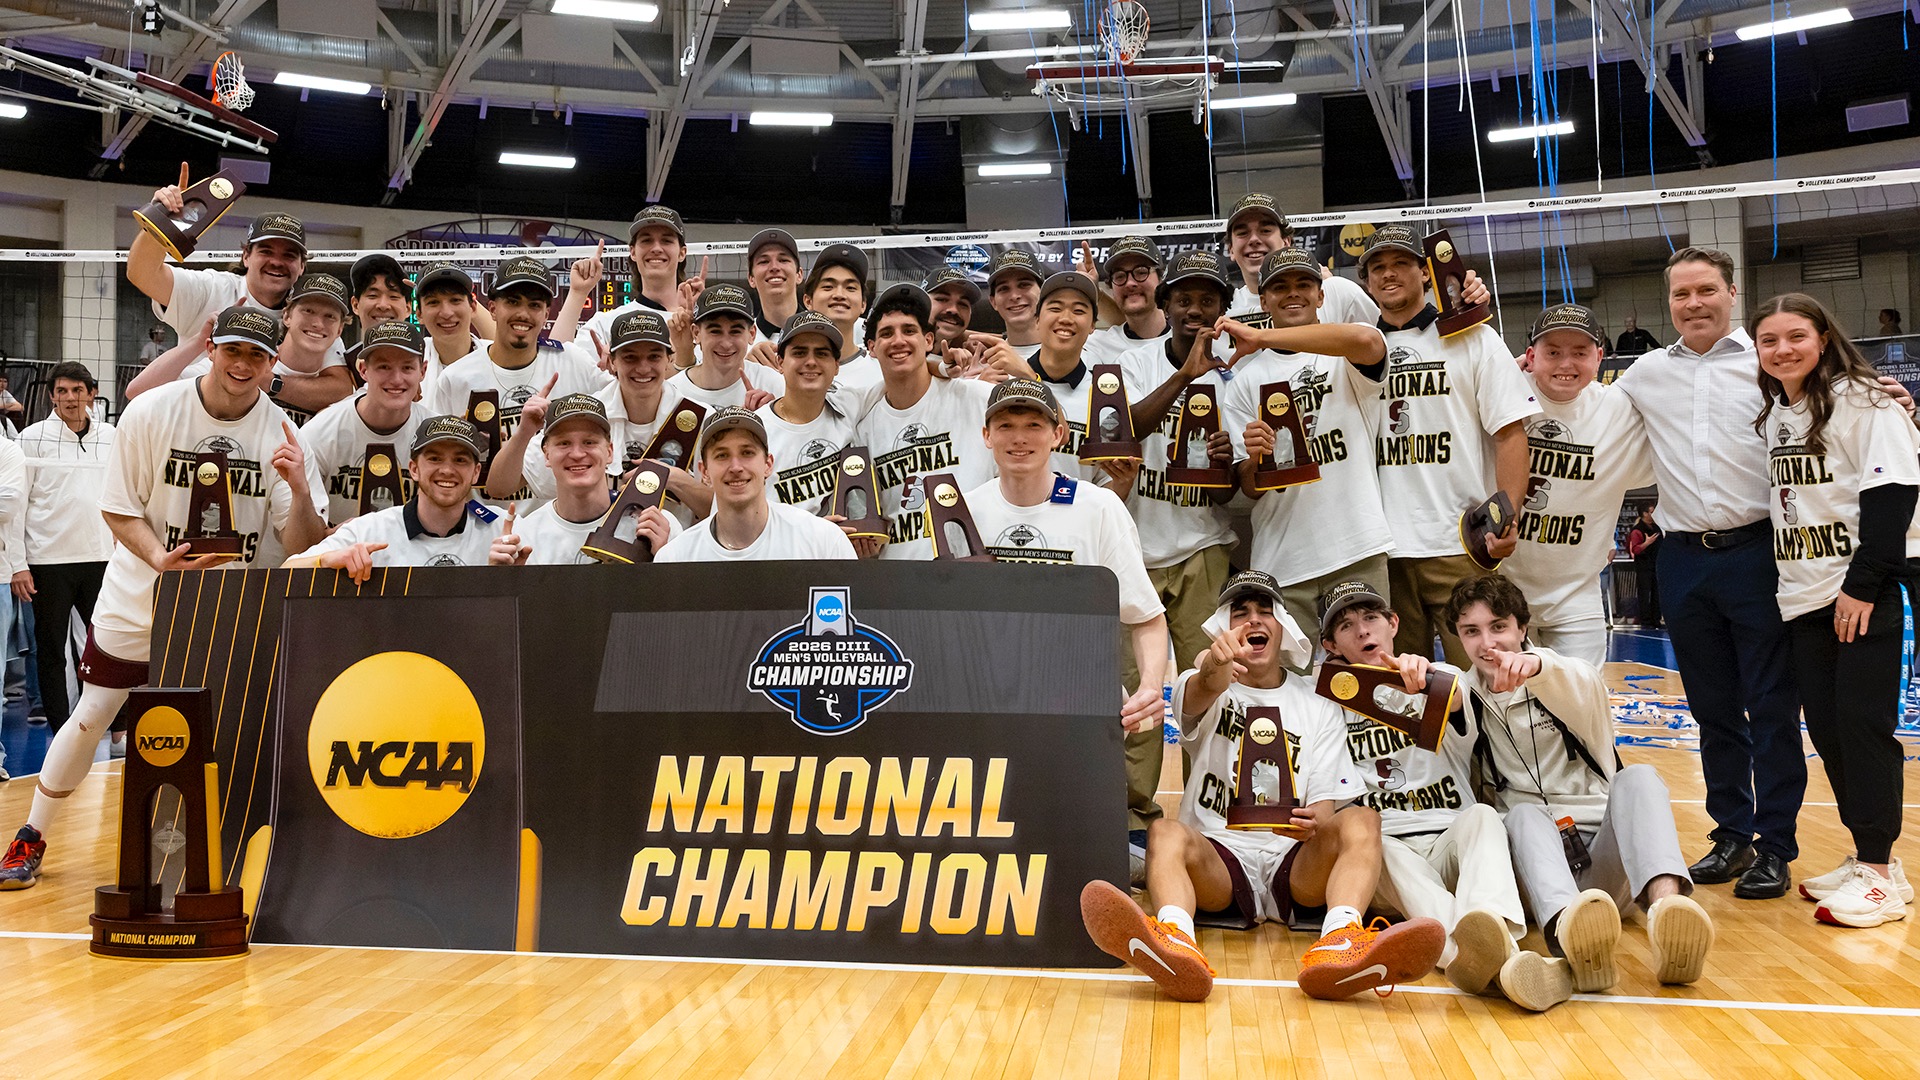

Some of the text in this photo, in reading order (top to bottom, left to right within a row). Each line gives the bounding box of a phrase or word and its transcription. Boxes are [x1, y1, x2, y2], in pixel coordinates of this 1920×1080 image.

[1836, 175, 1876, 184] CHAMPIONSHIP
[1698, 187, 1737, 195] CHAMPIONSHIP
[1564, 197, 1602, 205] CHAMPIONSHIP
[1436, 206, 1473, 215] CHAMPIONSHIP
[1310, 214, 1346, 222] CHAMPIONSHIP
[1071, 228, 1105, 236] CHAMPIONSHIP
[1380, 228, 1411, 237] National
[1050, 253, 1064, 263] BY
[1189, 254, 1217, 264] National
[1279, 250, 1309, 259] National
[517, 260, 545, 271] National
[606, 282, 614, 293] 6
[716, 288, 744, 298] National
[603, 295, 614, 305] 13
[1556, 308, 1588, 318] National
[242, 313, 274, 329] National
[629, 317, 658, 325] National
[377, 324, 409, 333] National
[1010, 380, 1044, 392] National
[568, 396, 599, 407] National
[441, 418, 472, 431] National
[1550, 443, 1565, 451] MEN'S
[938, 492, 957, 502] NCAA
[1024, 550, 1040, 558] MEN'S
[1040, 551, 1070, 560] VOLLEYBALL
[819, 608, 842, 616] NCAA
[788, 641, 871, 652] 2026 DIII
[773, 652, 886, 663] MEN'S VOLLEYBALL
[753, 665, 907, 686] CHAMPIONSHIP
[1252, 730, 1277, 738] NCAA
[139, 735, 186, 751] NCAA
[323, 740, 476, 794] NCAA
[646, 755, 1016, 838] NATIONAL
[619, 846, 1048, 936] CHAMPION
[110, 932, 197, 945] NATIONAL CHAMPION
